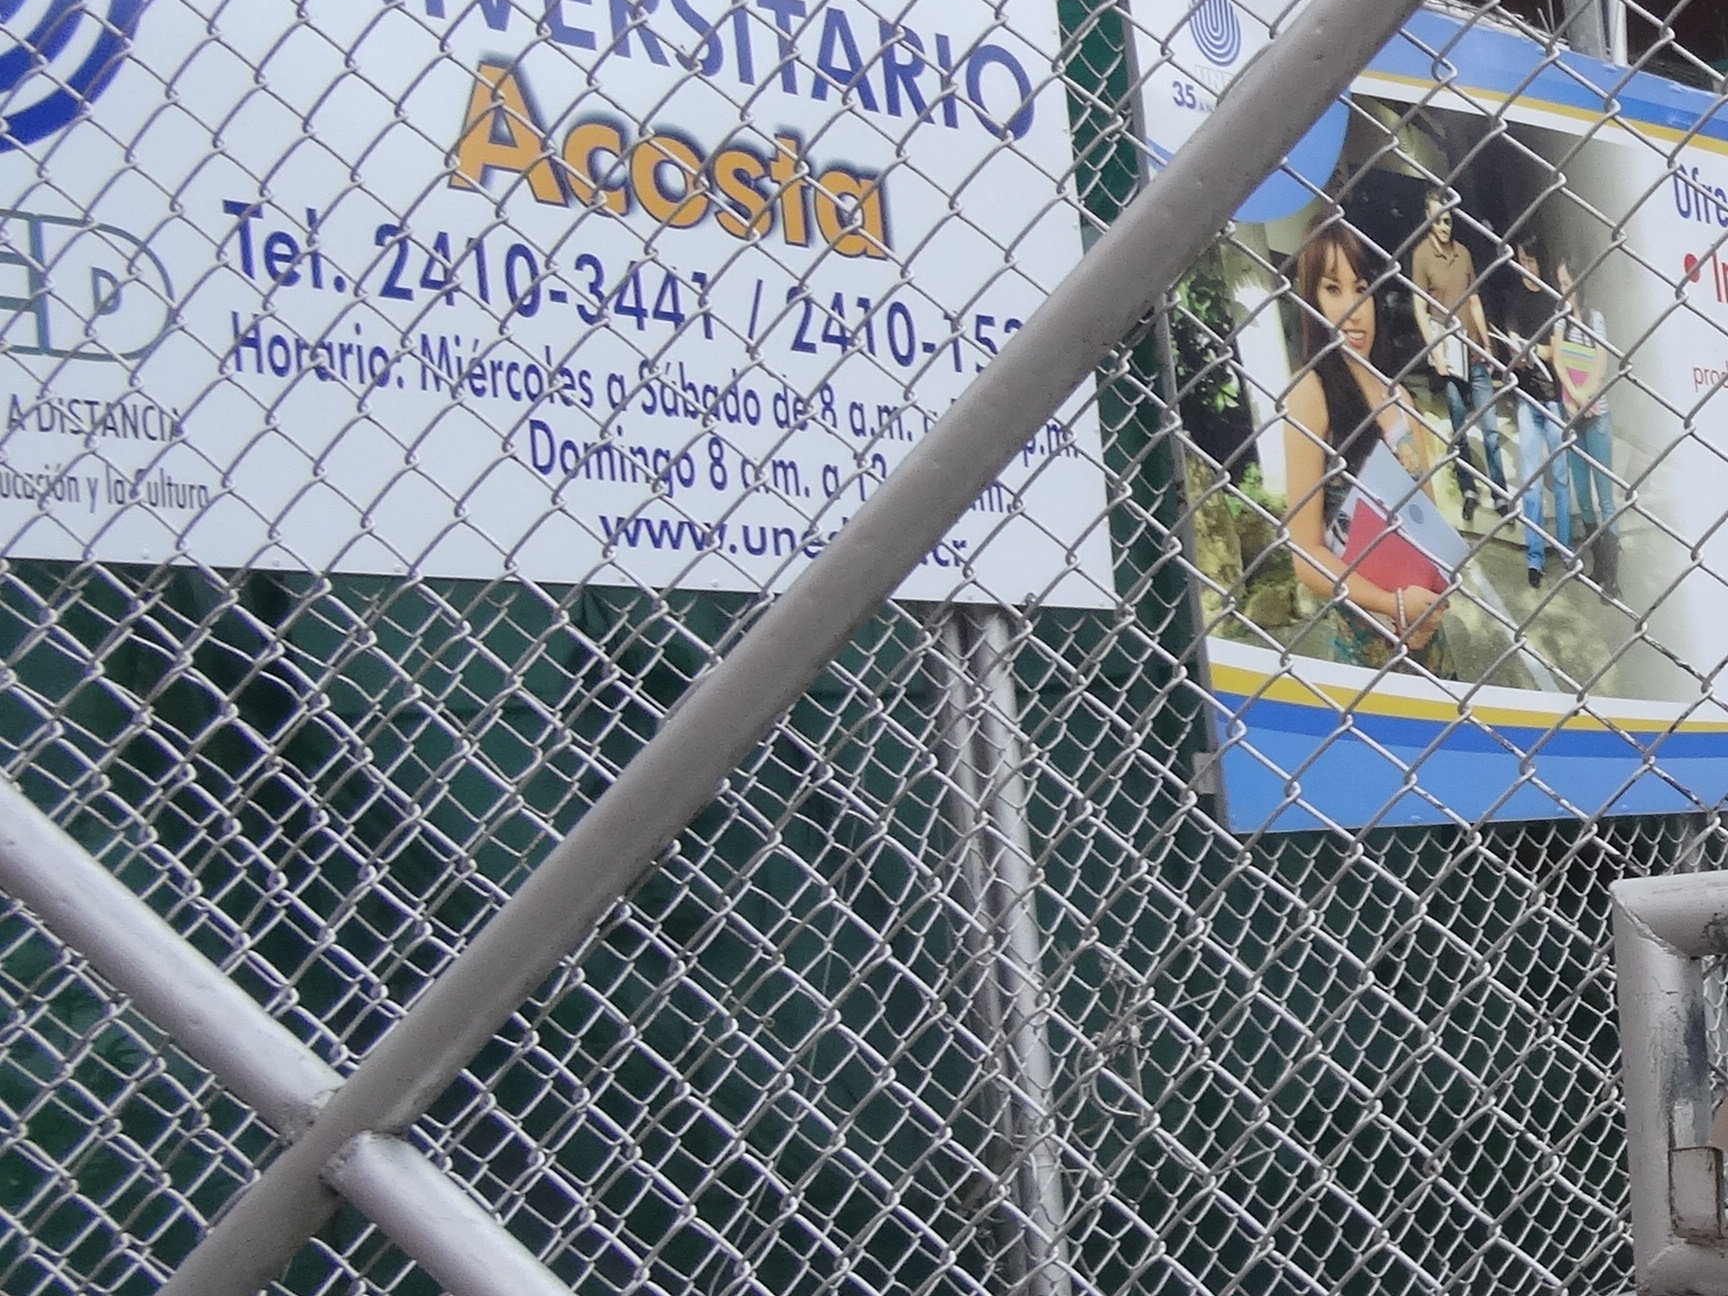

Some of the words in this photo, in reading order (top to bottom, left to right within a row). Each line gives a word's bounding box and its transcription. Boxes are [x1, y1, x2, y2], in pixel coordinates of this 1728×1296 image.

[1171, 80, 1197, 110] 35
[447, 58, 892, 262] Acosta
[222, 199, 346, 294] Tel.
[373, 223, 714, 341] 2410-3441
[785, 285, 1024, 374] 2410-15
[5, 392, 27, 433] A
[230, 310, 405, 390] Horario:
[420, 333, 594, 410] Miércoles
[607, 372, 627, 412] a
[637, 358, 761, 427] Sábado
[772, 373, 809, 431] de
[818, 382, 839, 430] 8
[849, 401, 913, 442] a.m.
[0, 462, 81, 503] ucación
[85, 476, 99, 514] y
[105, 461, 126, 506] la
[528, 418, 696, 499] Domingo
[707, 436, 728, 491] 8
[821, 463, 842, 500] a
